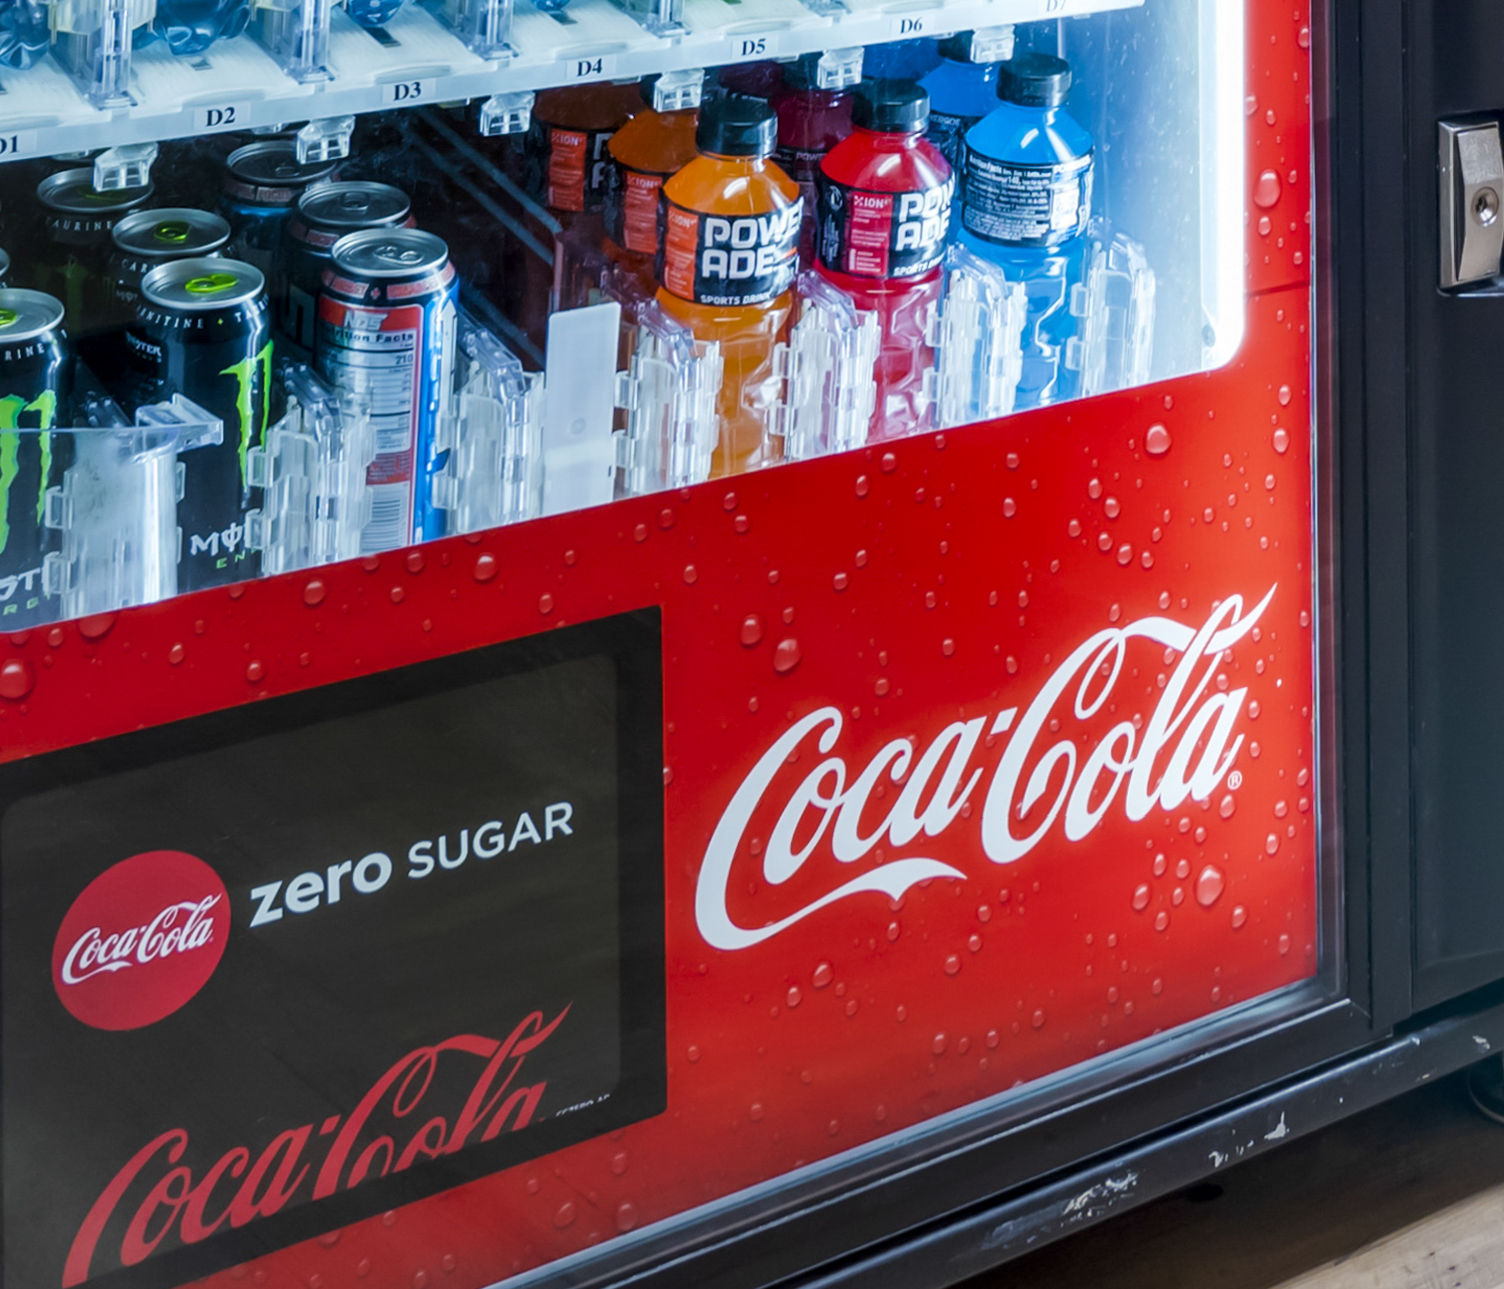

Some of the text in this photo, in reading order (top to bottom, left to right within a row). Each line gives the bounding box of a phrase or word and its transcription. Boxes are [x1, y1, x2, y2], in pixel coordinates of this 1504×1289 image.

[900, 16, 923, 35] D6
[741, 38, 766, 56] D5
[577, 58, 603, 77] D4
[393, 81, 422, 101] D3
[205, 106, 236, 127] D2
[46, 215, 113, 232] TAURINE
[700, 293, 741, 306] SPORTS
[376, 332, 414, 343] Facts
[396, 353, 413, 365] 210
[694, 581, 1279, 951] Coca-Cola
[250, 801, 575, 929] zero SUGAR
[61, 892, 223, 986] Coca-Cola
[62, 1000, 574, 1289] Coca-Cola
